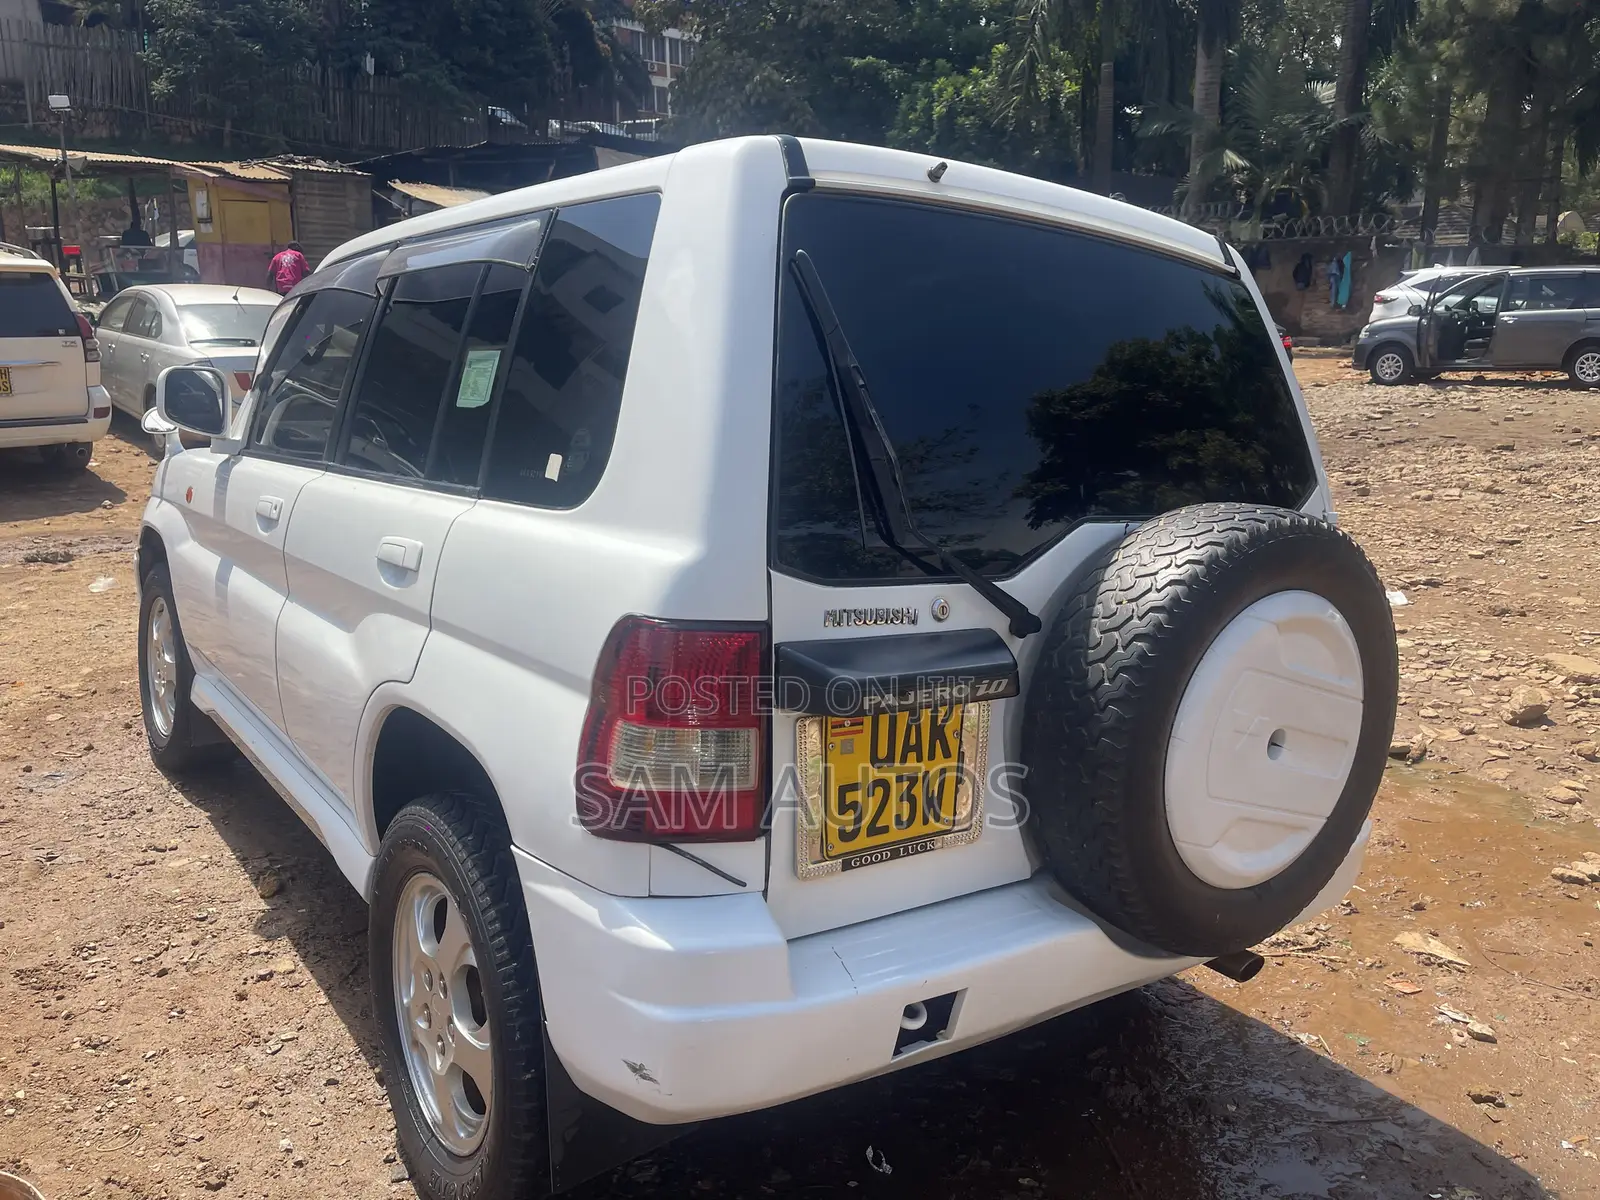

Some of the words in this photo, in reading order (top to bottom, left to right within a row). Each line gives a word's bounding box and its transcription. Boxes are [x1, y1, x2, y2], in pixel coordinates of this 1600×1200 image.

[823, 606, 919, 628] MITSUBISHI
[862, 684, 970, 710] PAJERO
[869, 705, 953, 769] UAK
[837, 767, 947, 843] 523W
[851, 850, 891, 868] GOOD
[899, 841, 936, 857] LUCK
